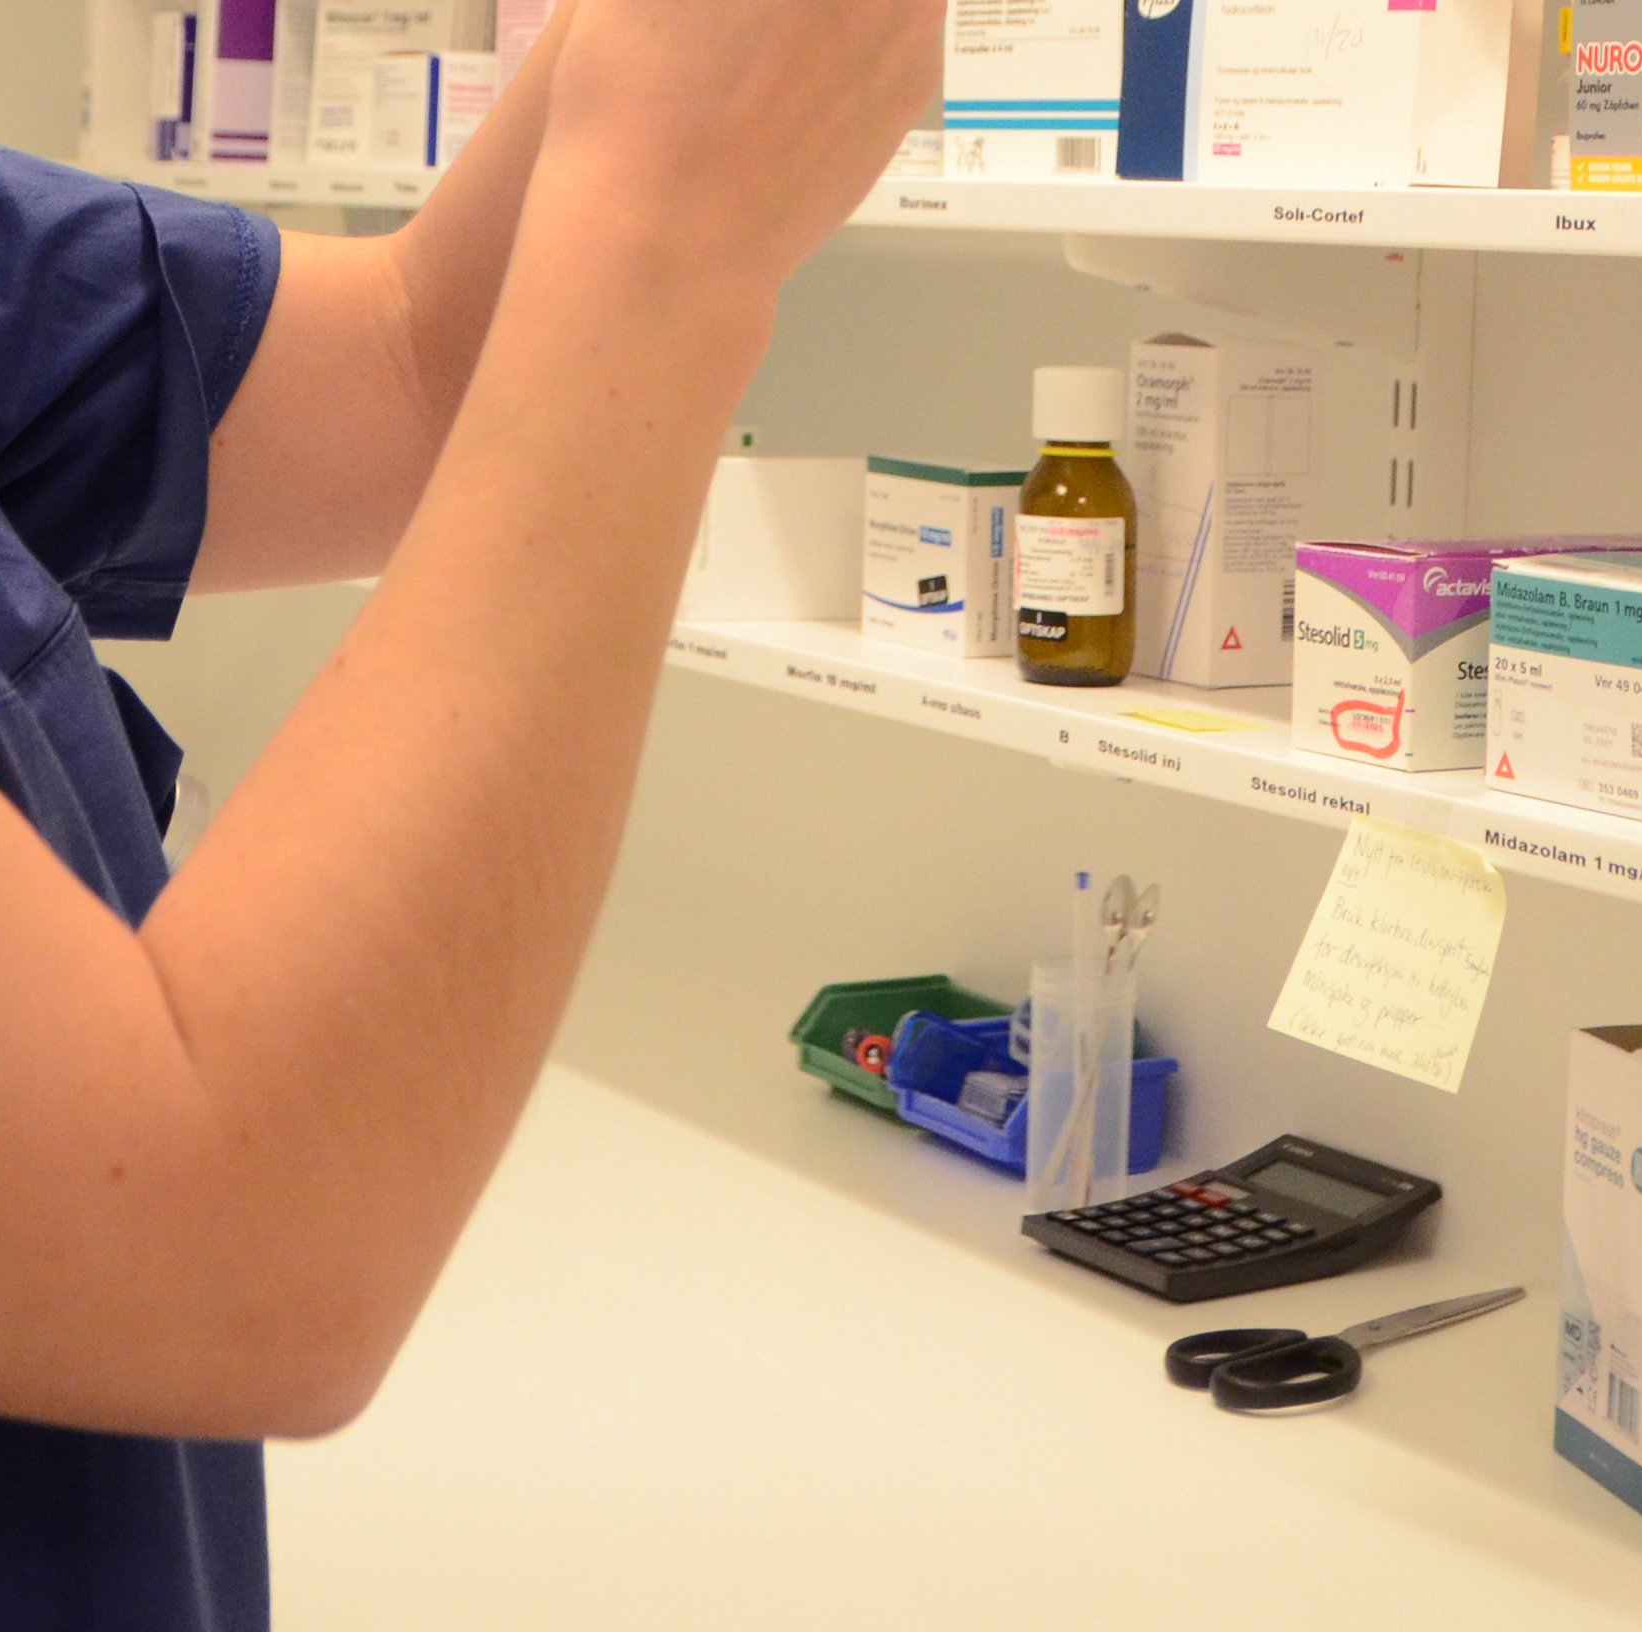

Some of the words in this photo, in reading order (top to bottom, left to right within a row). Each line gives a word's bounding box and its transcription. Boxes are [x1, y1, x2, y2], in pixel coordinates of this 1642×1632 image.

[1576, 80, 1613, 96] Junior
[1555, 215, 1597, 232] Ibux
[1435, 578, 1493, 598] actavis
[1495, 579, 1556, 607] Midazolam
[1559, 591, 1571, 610] B.
[1574, 596, 1610, 615] Braun
[1614, 601, 1622, 617] 1
[1298, 620, 1351, 649] Stesolid
[1355, 631, 1363, 649] 5
[1365, 639, 1379, 653] mg
[1494, 656, 1509, 671] 20
[1510, 661, 1518, 672] x
[1519, 661, 1528, 674] 5
[1530, 663, 1543, 677] ml
[1594, 674, 1613, 689] Vnr
[1615, 679, 1631, 694] 49
[1059, 730, 1069, 744] B
[1097, 740, 1157, 766] Stesolid
[1163, 755, 1181, 771] inj
[1251, 776, 1318, 804] Stesolid
[1322, 794, 1371, 817] rektal
[1484, 828, 1587, 868] Midazolam
[1594, 855, 1603, 872] 1
